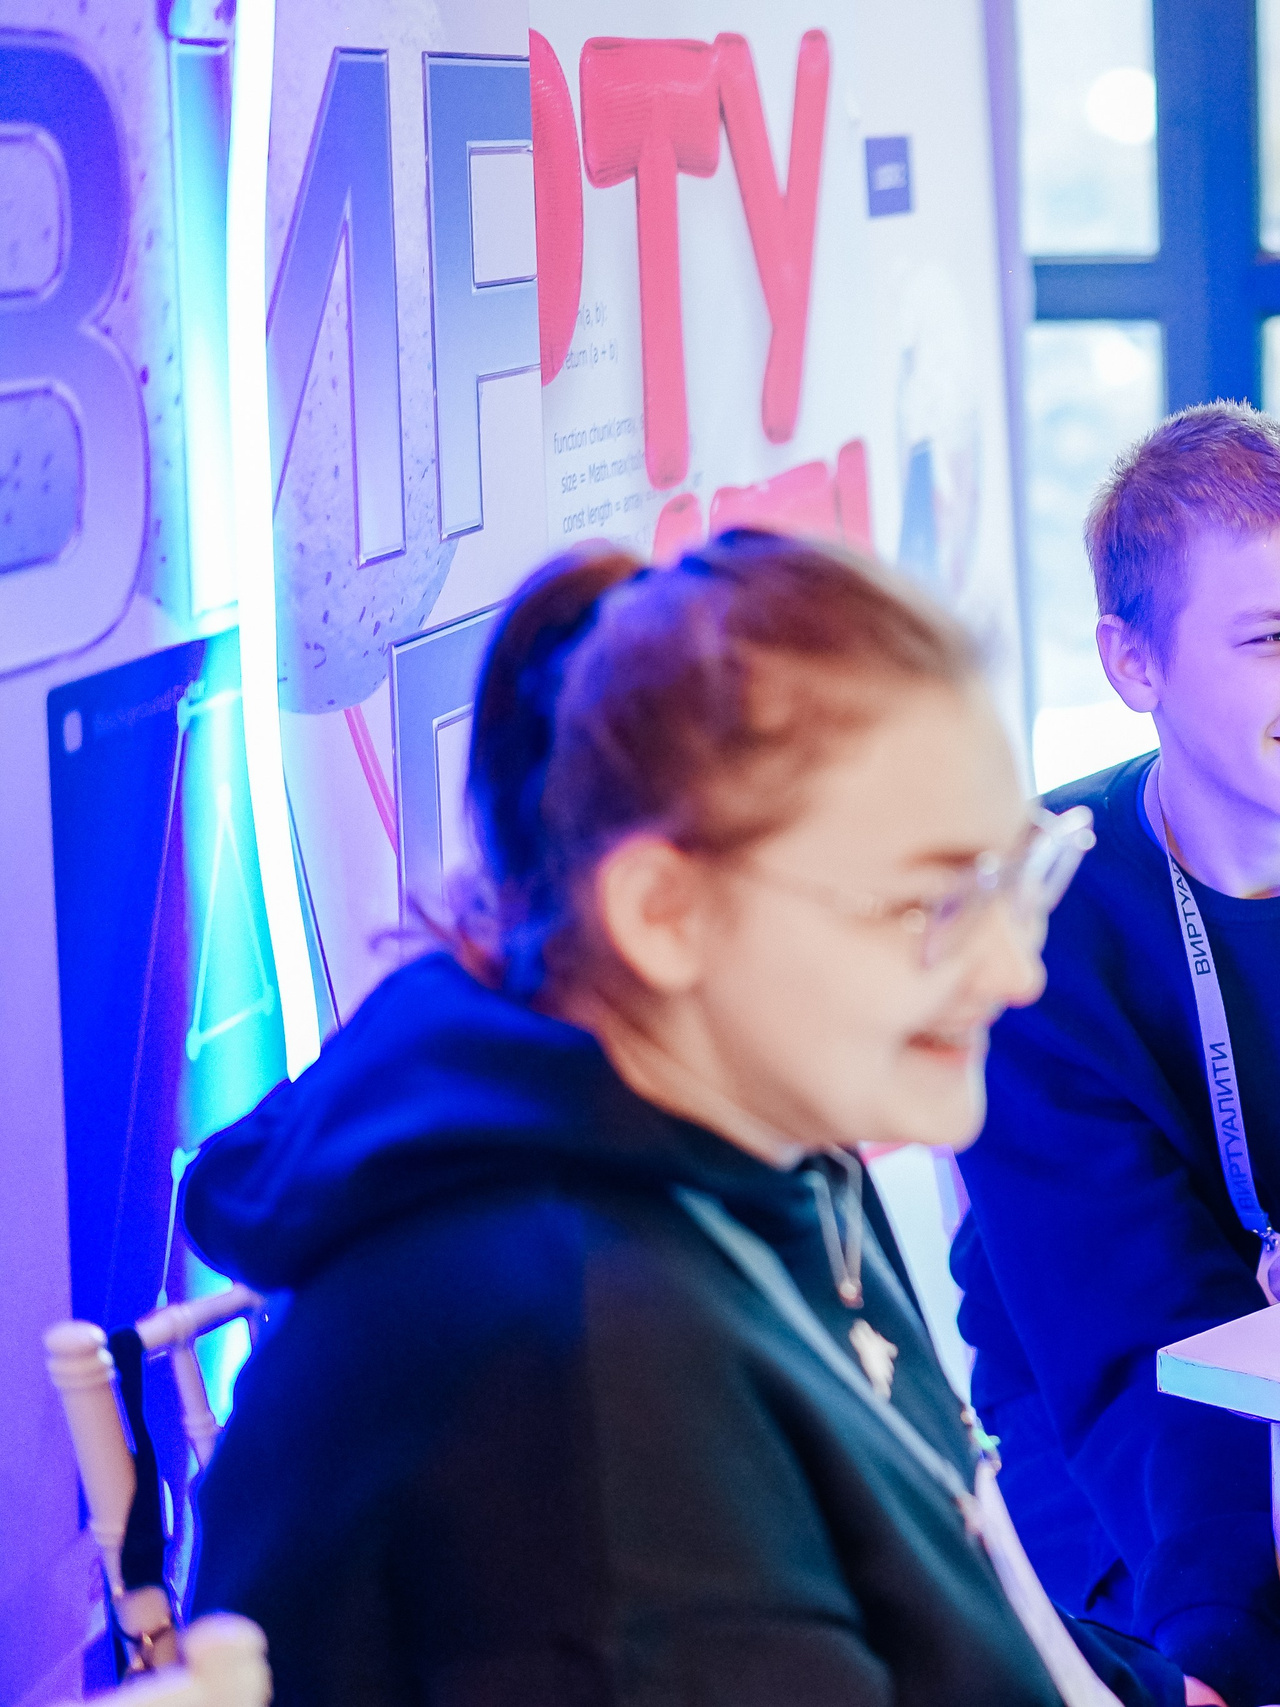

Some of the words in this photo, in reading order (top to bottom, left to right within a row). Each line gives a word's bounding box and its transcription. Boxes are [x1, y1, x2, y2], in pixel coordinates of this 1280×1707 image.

[553, 427, 588, 455] function
[561, 472, 578, 495] size
[563, 508, 586, 535] const
[588, 498, 613, 528] length
[1209, 1041, 1257, 1215] ВИРТУАЛИТИ
